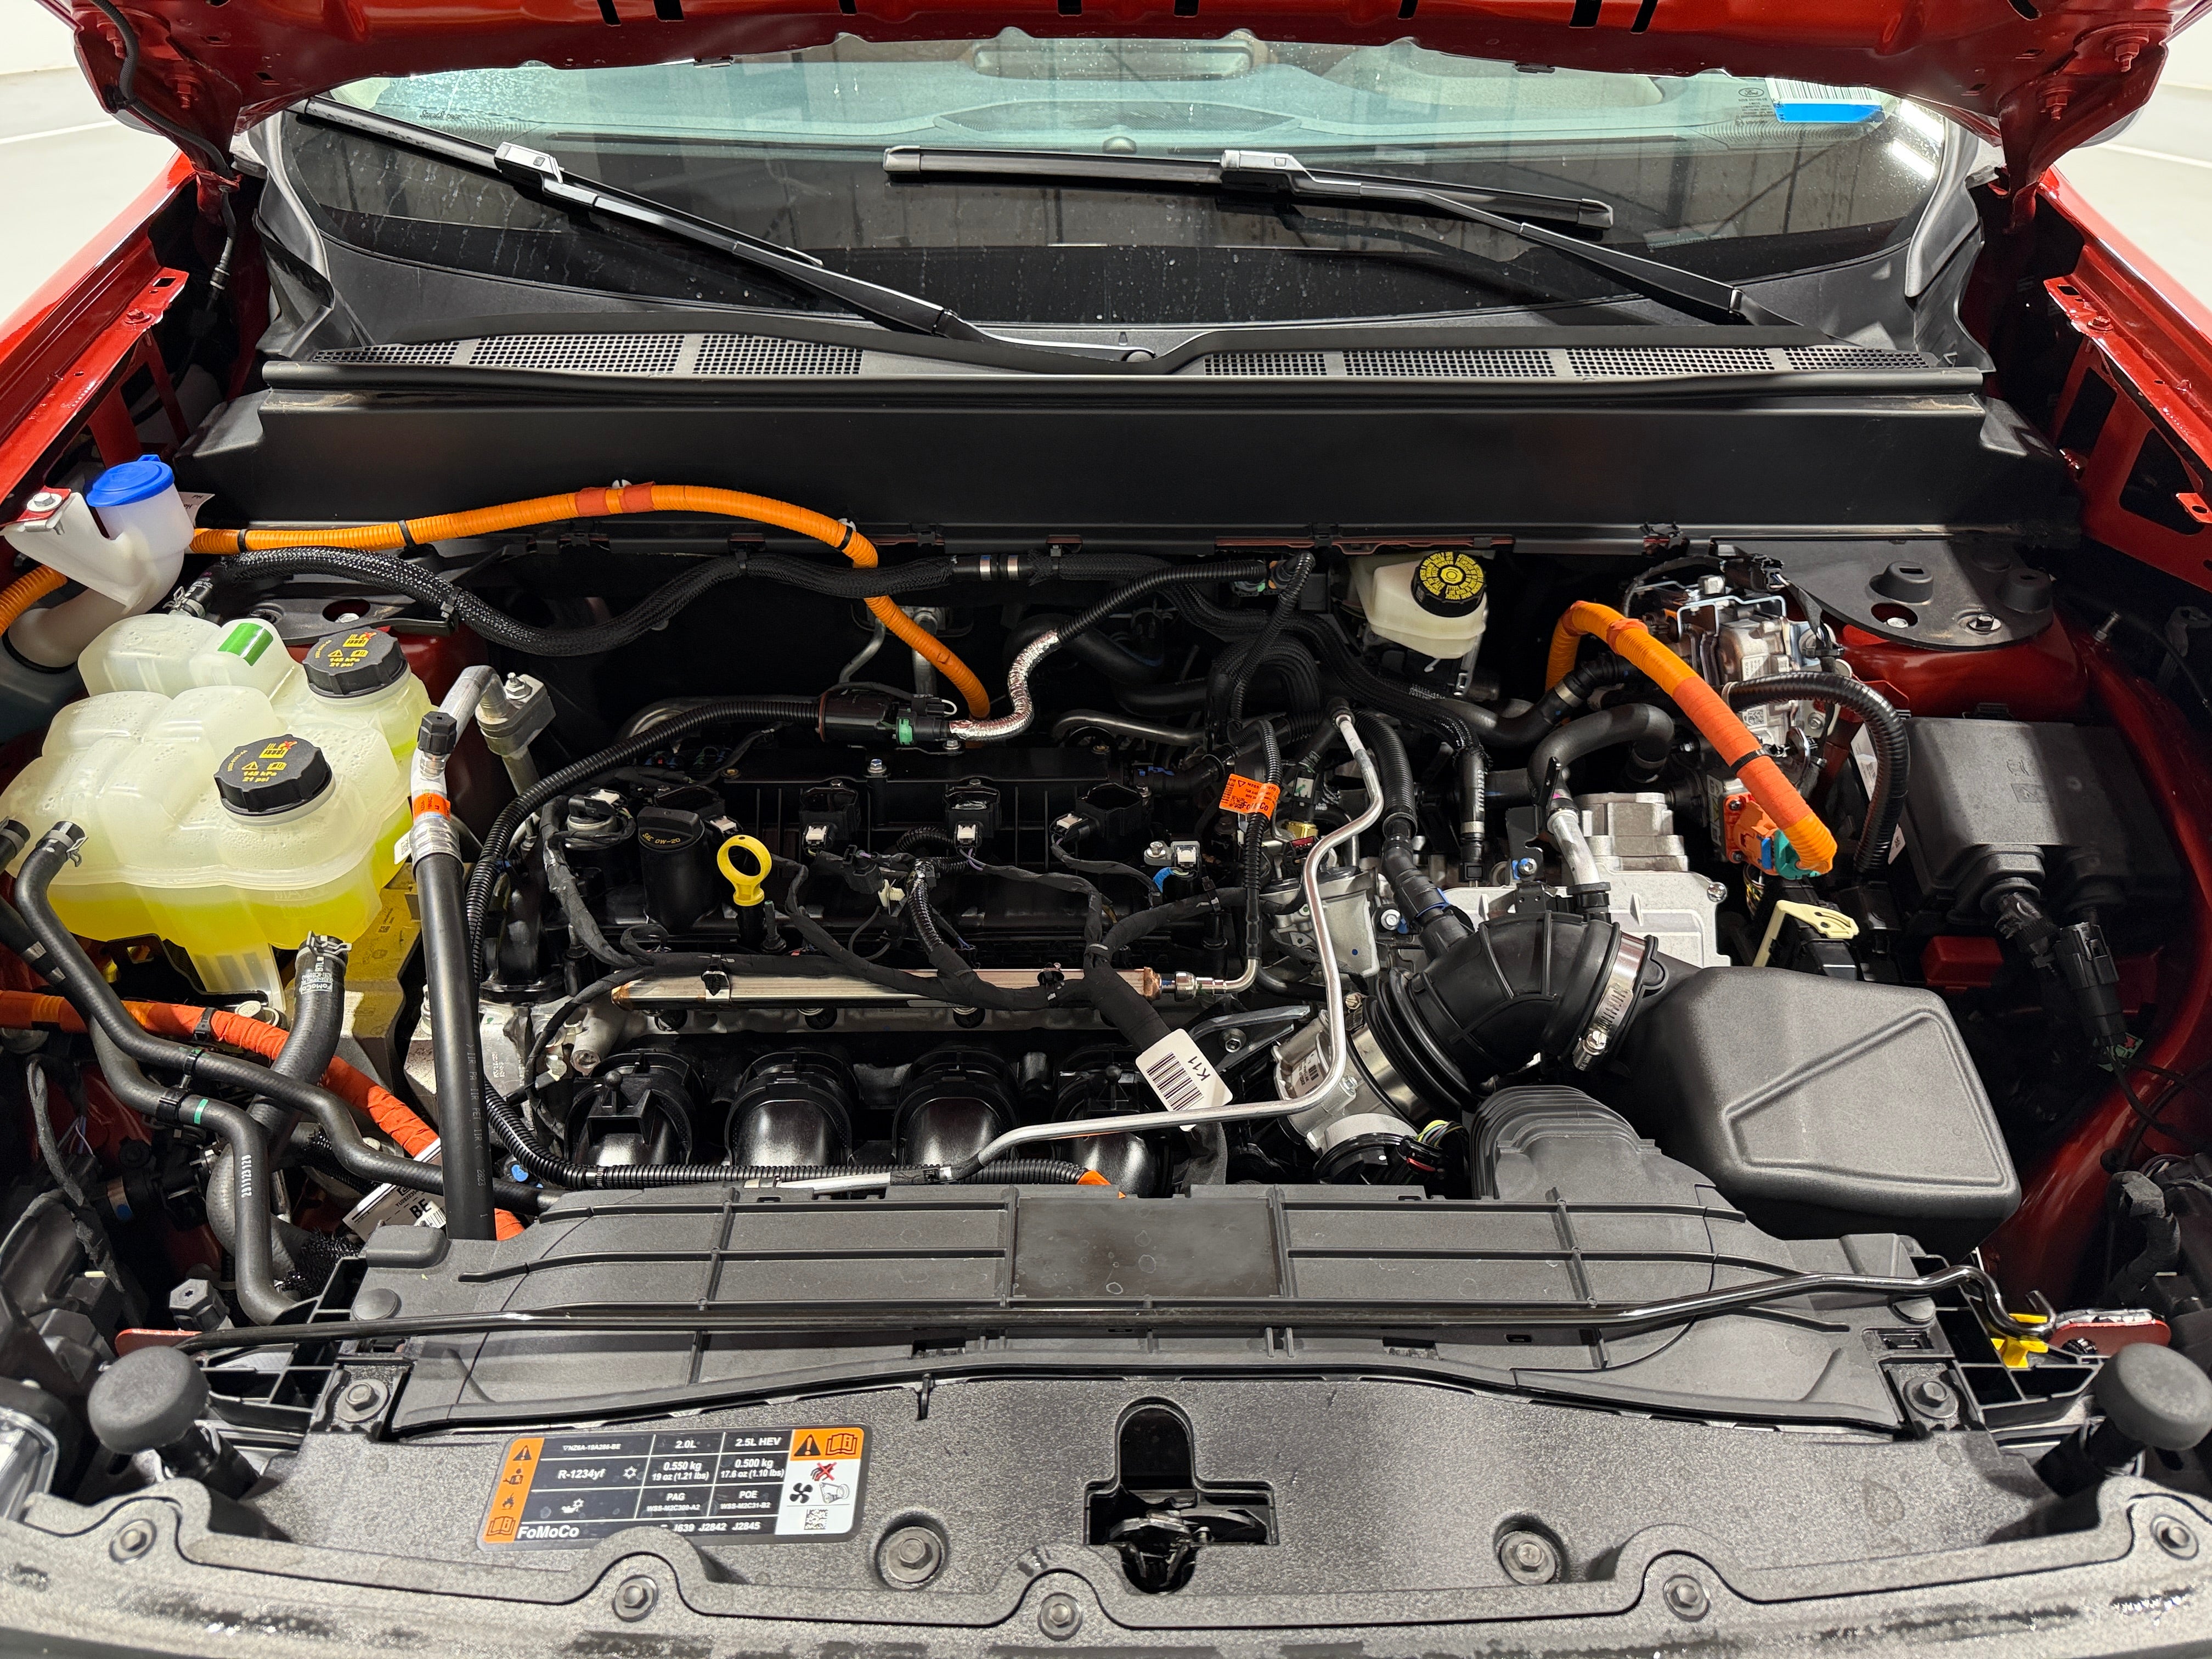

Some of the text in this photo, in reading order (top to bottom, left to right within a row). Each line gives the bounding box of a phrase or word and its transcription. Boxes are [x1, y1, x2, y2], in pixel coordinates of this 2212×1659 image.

[642, 833, 653, 843] SAE
[302, 983, 331, 991] FoMoCo
[1188, 1056, 1211, 1081] K11
[472, 1107, 482, 1120] PET
[477, 1169, 487, 1187] 2823
[409, 1198, 432, 1219] BE
[675, 1440, 697, 1449] 2.0L
[735, 1437, 781, 1447] 2.5L HEV
[663, 1461, 702, 1472] 0.550 kg
[735, 1458, 774, 1469] 0.500 kg
[557, 1468, 607, 1481] R-1234yf
[674, 1472, 692, 1482] (1.21
[695, 1471, 709, 1481] lbs)
[749, 1469, 768, 1479] (1.10
[769, 1469, 785, 1478] lbs)
[666, 1492, 685, 1501] PAG
[738, 1490, 758, 1499] POE
[698, 1522, 728, 1531] J2842
[732, 1521, 761, 1531] J2845
[517, 1525, 580, 1539] FoMoCo
